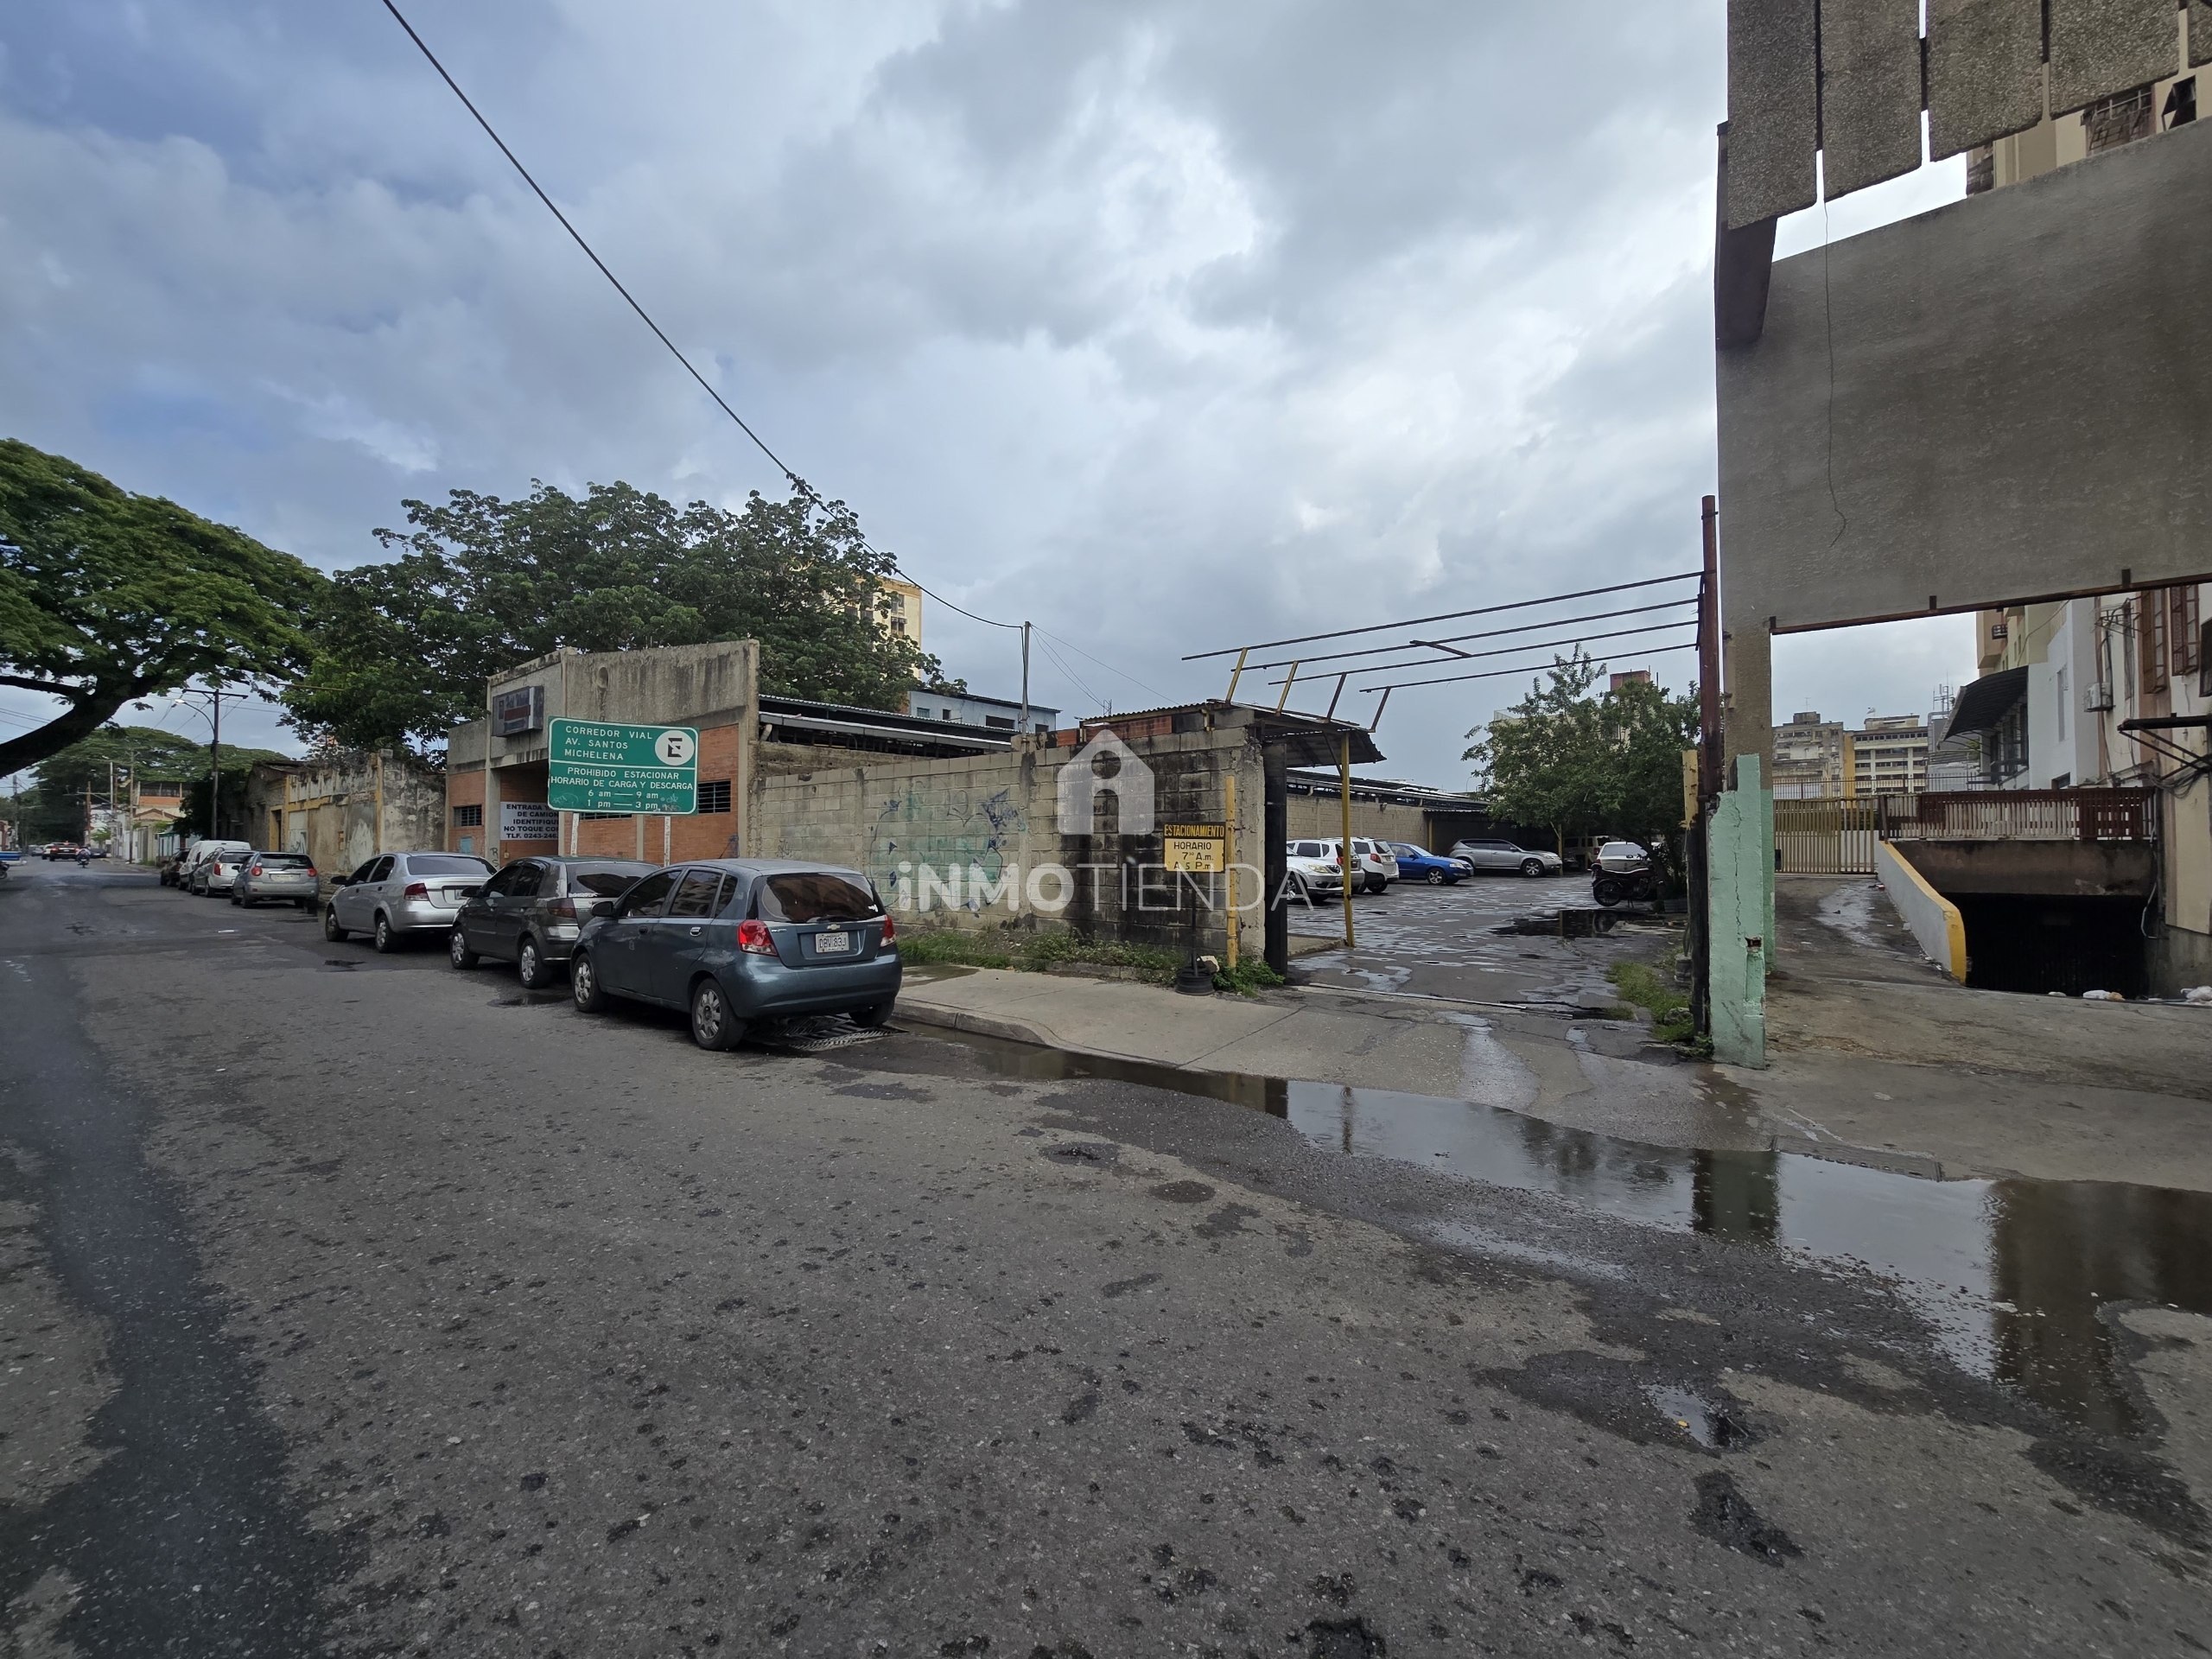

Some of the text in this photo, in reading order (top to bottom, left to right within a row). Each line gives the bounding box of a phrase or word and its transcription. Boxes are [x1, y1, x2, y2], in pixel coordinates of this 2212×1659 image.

[565, 725, 652, 740] CORREDOR VIAL
[565, 737, 628, 749] AV. SANTOS
[564, 748, 624, 760] MICHELENA
[567, 767, 679, 779] PROHIBIDO ESTACIONAR
[550, 776, 589, 785] HORARIO
[1164, 824, 1224, 837] ESTACIONAMIENTO
[1173, 842, 1211, 850] HORARIO
